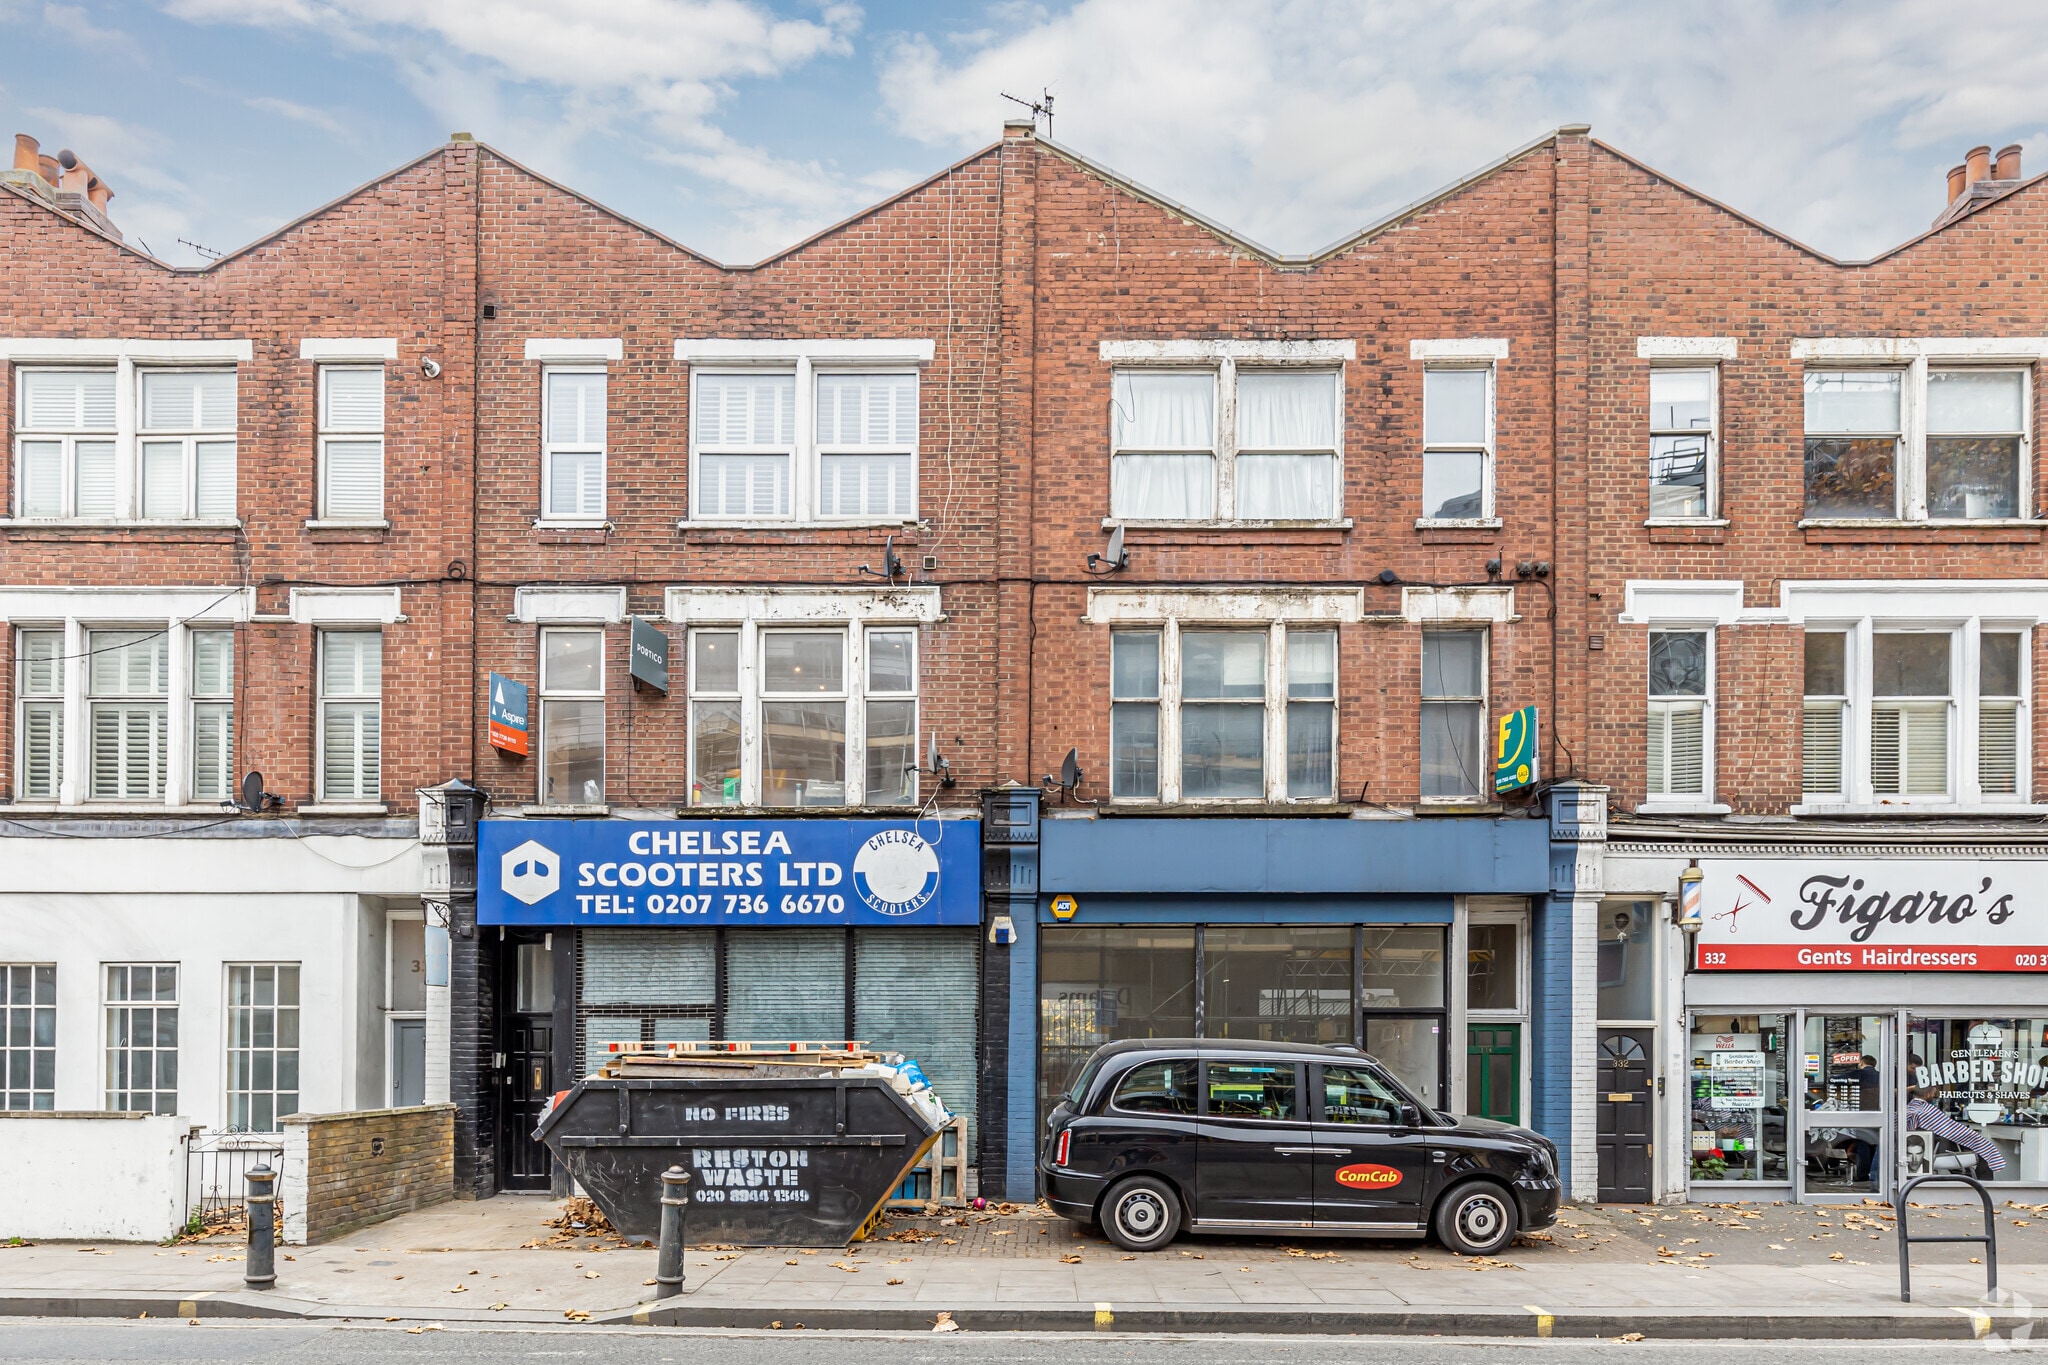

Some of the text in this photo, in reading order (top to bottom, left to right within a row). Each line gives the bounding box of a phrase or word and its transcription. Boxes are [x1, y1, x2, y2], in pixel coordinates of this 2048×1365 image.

[636, 643, 663, 665] PORTICO
[501, 708, 525, 726] Aspire
[628, 830, 792, 855] CHELSEA
[868, 830, 924, 852] CHELSEA
[578, 862, 842, 887] SCOOTERS LTD
[576, 894, 845, 914] TEL: 0207 736 6670
[866, 893, 927, 914] SCOOTERS
[1057, 902, 1070, 910] ADT
[1790, 874, 2014, 942] Figaro's
[1704, 952, 1727, 964] 332
[1797, 948, 1977, 966] Gents Hairdressers
[2015, 954, 2038, 966] 020
[1951, 1049, 2020, 1059] GENTLEMEN'S
[1612, 1059, 1629, 1068] 332
[1915, 1060, 1996, 1089] BARBER
[1939, 1090, 2031, 1100] HAIRCUTS & SHAVES
[685, 1105, 790, 1121] NO FIRES
[702, 1169, 799, 1187] WASTE
[1339, 1170, 1398, 1182] ComCab
[696, 1190, 725, 1202] 020
